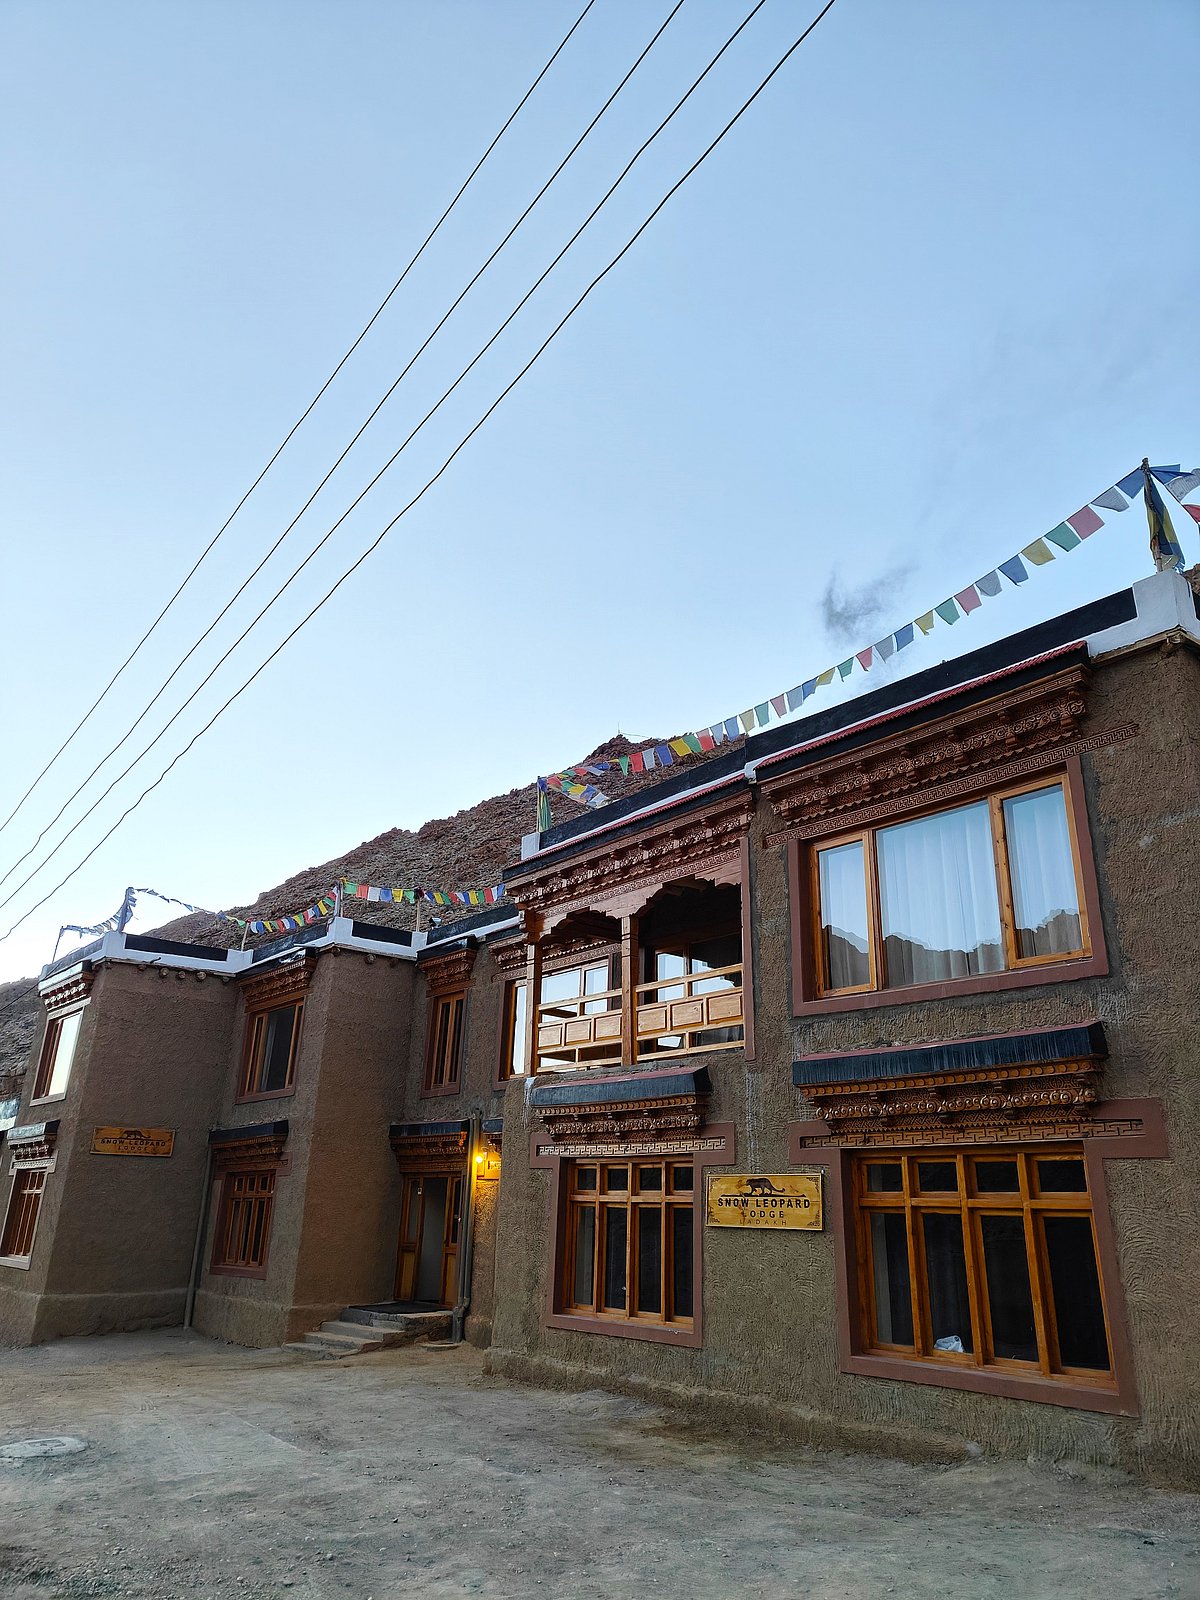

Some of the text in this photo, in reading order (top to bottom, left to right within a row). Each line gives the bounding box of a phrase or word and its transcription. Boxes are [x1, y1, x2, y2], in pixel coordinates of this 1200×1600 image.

[717, 1198, 810, 1208] SNOW LEOPARD
[743, 1210, 785, 1218] ODGE
